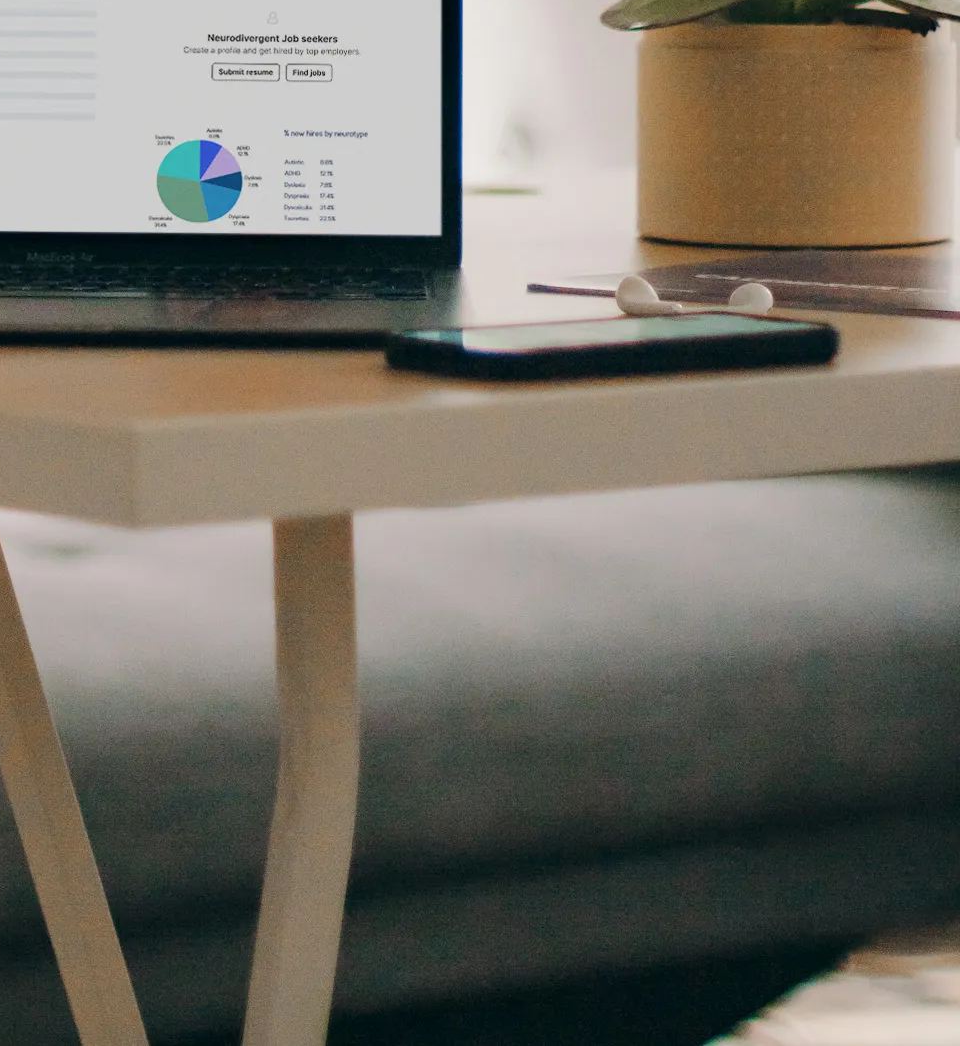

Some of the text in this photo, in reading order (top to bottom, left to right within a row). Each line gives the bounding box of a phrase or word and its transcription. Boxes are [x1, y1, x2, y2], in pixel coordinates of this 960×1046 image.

[207, 34, 338, 44] Neurodivergent Job seekers
[183, 46, 209, 54] Create
[217, 46, 241, 56] profile
[259, 47, 272, 56] get
[273, 47, 293, 55] hired
[294, 47, 304, 56] by
[306, 48, 319, 56] top
[218, 68, 245, 76] Submit
[309, 69, 326, 77] jobs
[284, 129, 290, 137] %
[306, 129, 323, 137] hires
[324, 130, 333, 138] by
[334, 130, 369, 139] neurotype
